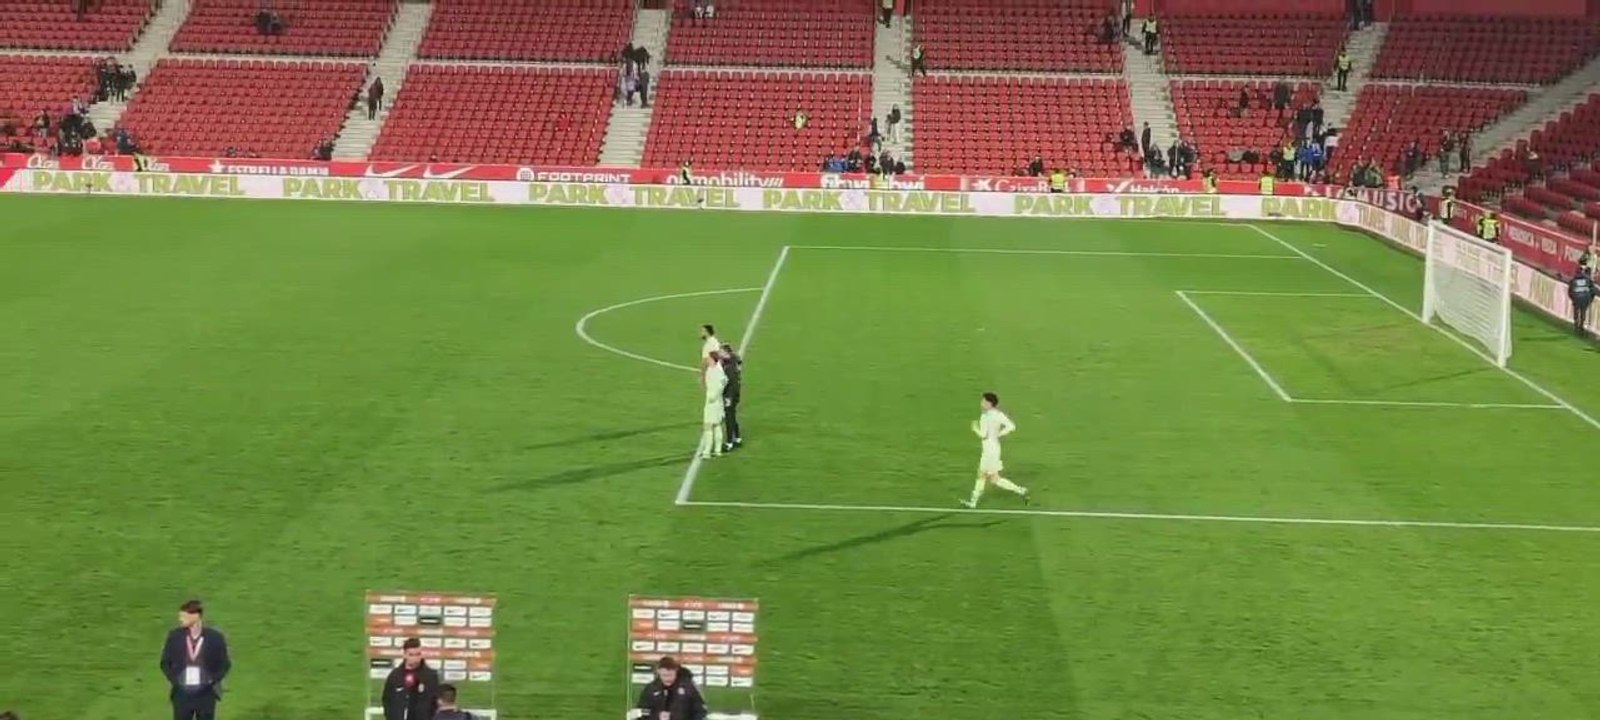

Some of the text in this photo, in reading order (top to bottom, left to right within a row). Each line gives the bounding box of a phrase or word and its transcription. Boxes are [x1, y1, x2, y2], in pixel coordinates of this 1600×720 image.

[33, 171, 244, 195] PARK TRAVEL
[283, 176, 494, 201] PARK TRAVEL
[537, 172, 632, 182] FOOTPRINT
[529, 182, 740, 208] PARK TRAVEL
[763, 188, 976, 212] PARK TRAVEL
[1015, 194, 1226, 216] PARK TRAVEL
[1261, 197, 1338, 219] PARK
